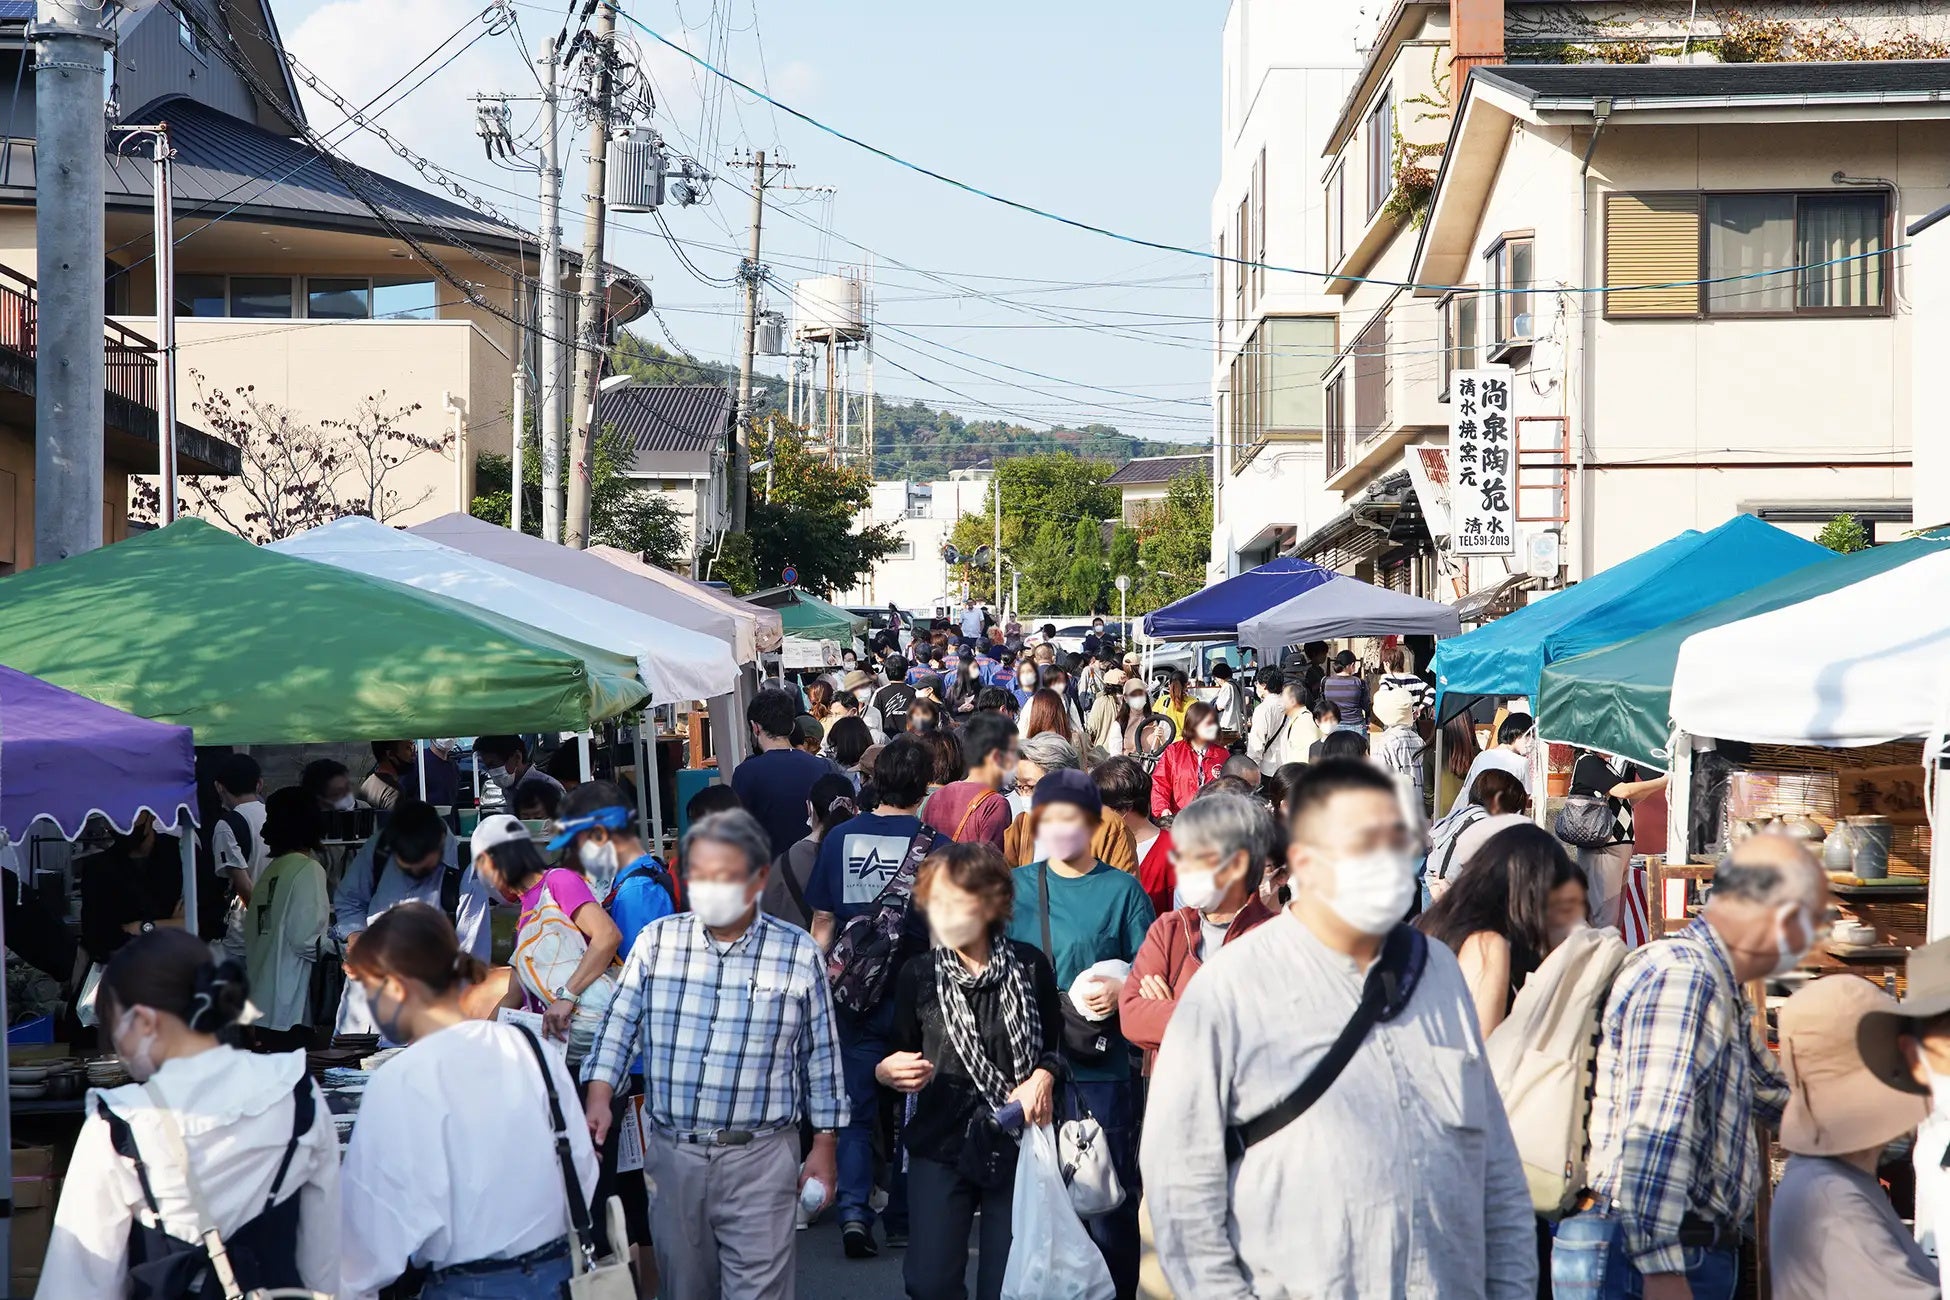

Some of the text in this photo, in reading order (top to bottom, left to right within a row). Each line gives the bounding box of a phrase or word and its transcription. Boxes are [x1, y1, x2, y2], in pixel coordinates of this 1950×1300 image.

[1459, 378, 1477, 486] 清水焼窯元
[1480, 379, 1509, 511] 尚泉陶苑
[1465, 516, 1503, 534] 清水
